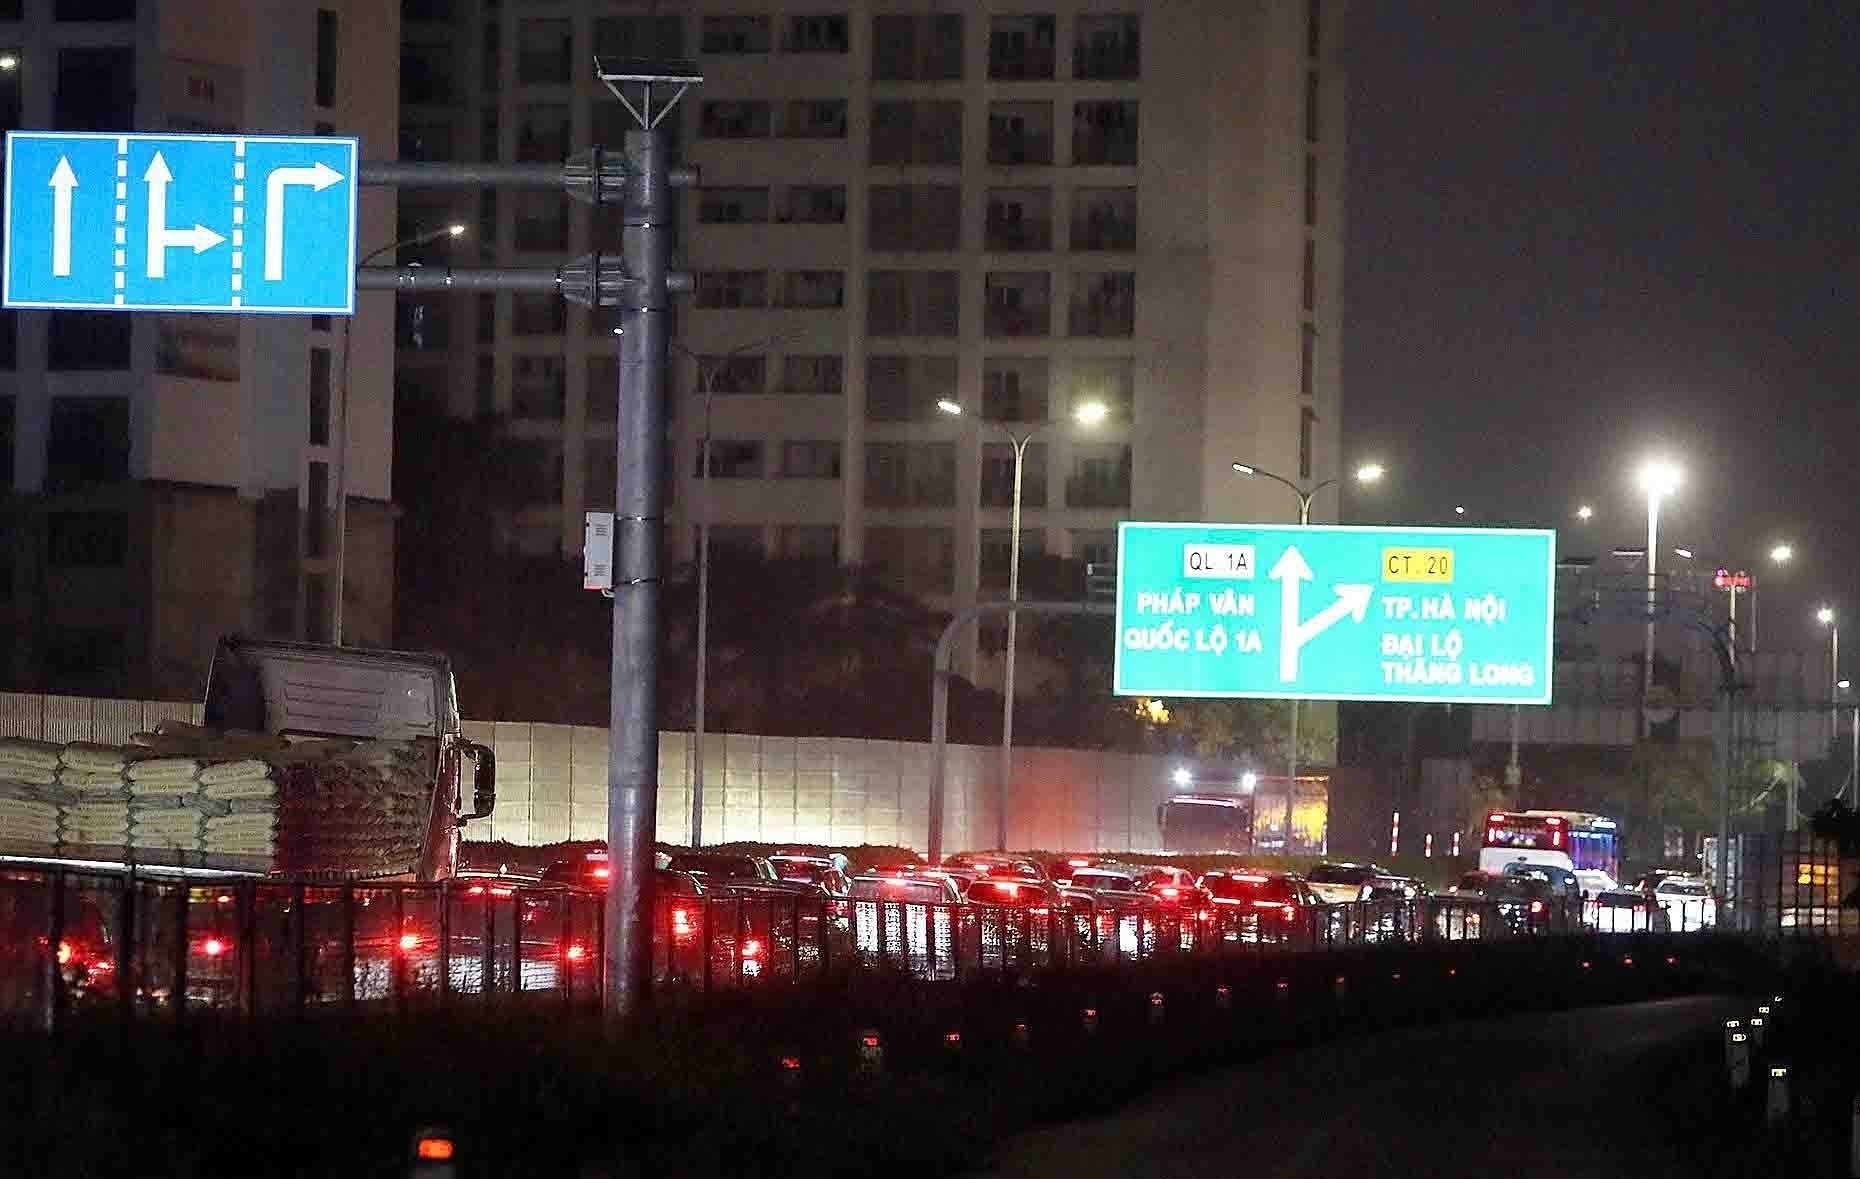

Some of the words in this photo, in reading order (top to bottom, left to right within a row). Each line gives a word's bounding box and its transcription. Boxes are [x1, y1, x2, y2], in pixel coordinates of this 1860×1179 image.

[1190, 552, 1214, 571] QL
[1227, 553, 1248, 571] 1A
[1137, 586, 1200, 615] PHÁP
[1208, 588, 1256, 616] VÂN
[1463, 593, 1506, 625] NỘI
[1124, 620, 1190, 651] QUỐC
[1195, 624, 1228, 656] LỘ
[1235, 629, 1263, 652] 1A
[1381, 632, 1423, 660] ĐẠI
[1431, 629, 1464, 660] LỘ
[1469, 662, 1535, 687] LONG
